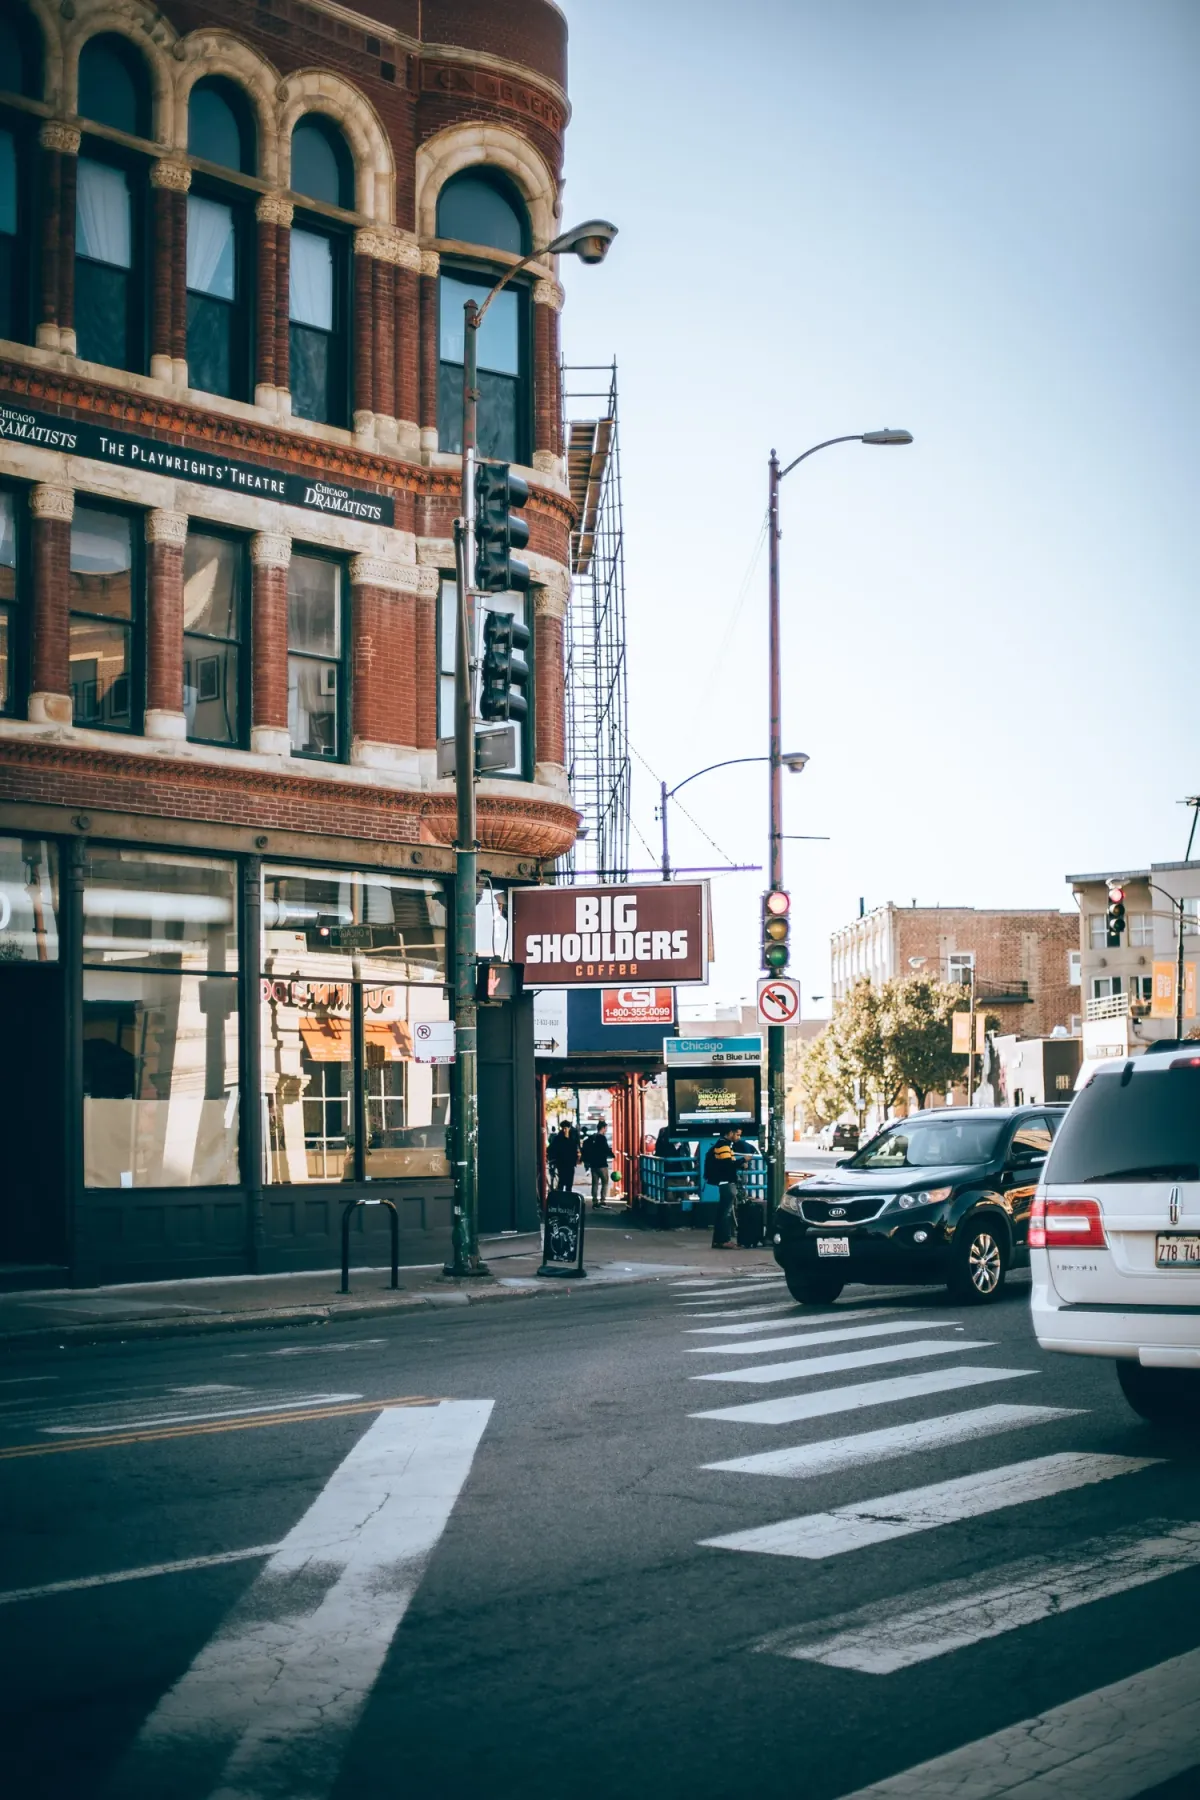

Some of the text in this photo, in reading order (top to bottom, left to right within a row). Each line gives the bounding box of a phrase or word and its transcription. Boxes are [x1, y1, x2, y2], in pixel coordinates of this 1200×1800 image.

[100, 437, 125, 457] THE
[230, 468, 285, 494] THEATRE
[315, 482, 348, 499] CHICAGO
[304, 487, 382, 520] DRAMATISTS
[575, 895, 637, 933] BIG
[526, 930, 688, 963] SHOULDERS
[618, 988, 656, 1008] CSI
[605, 1007, 670, 1017] 1-800-355-0099
[681, 1041, 723, 1052] Chicago
[712, 1053, 760, 1061] cta Blue Line
[1159, 1244, 1178, 1261] Z78
